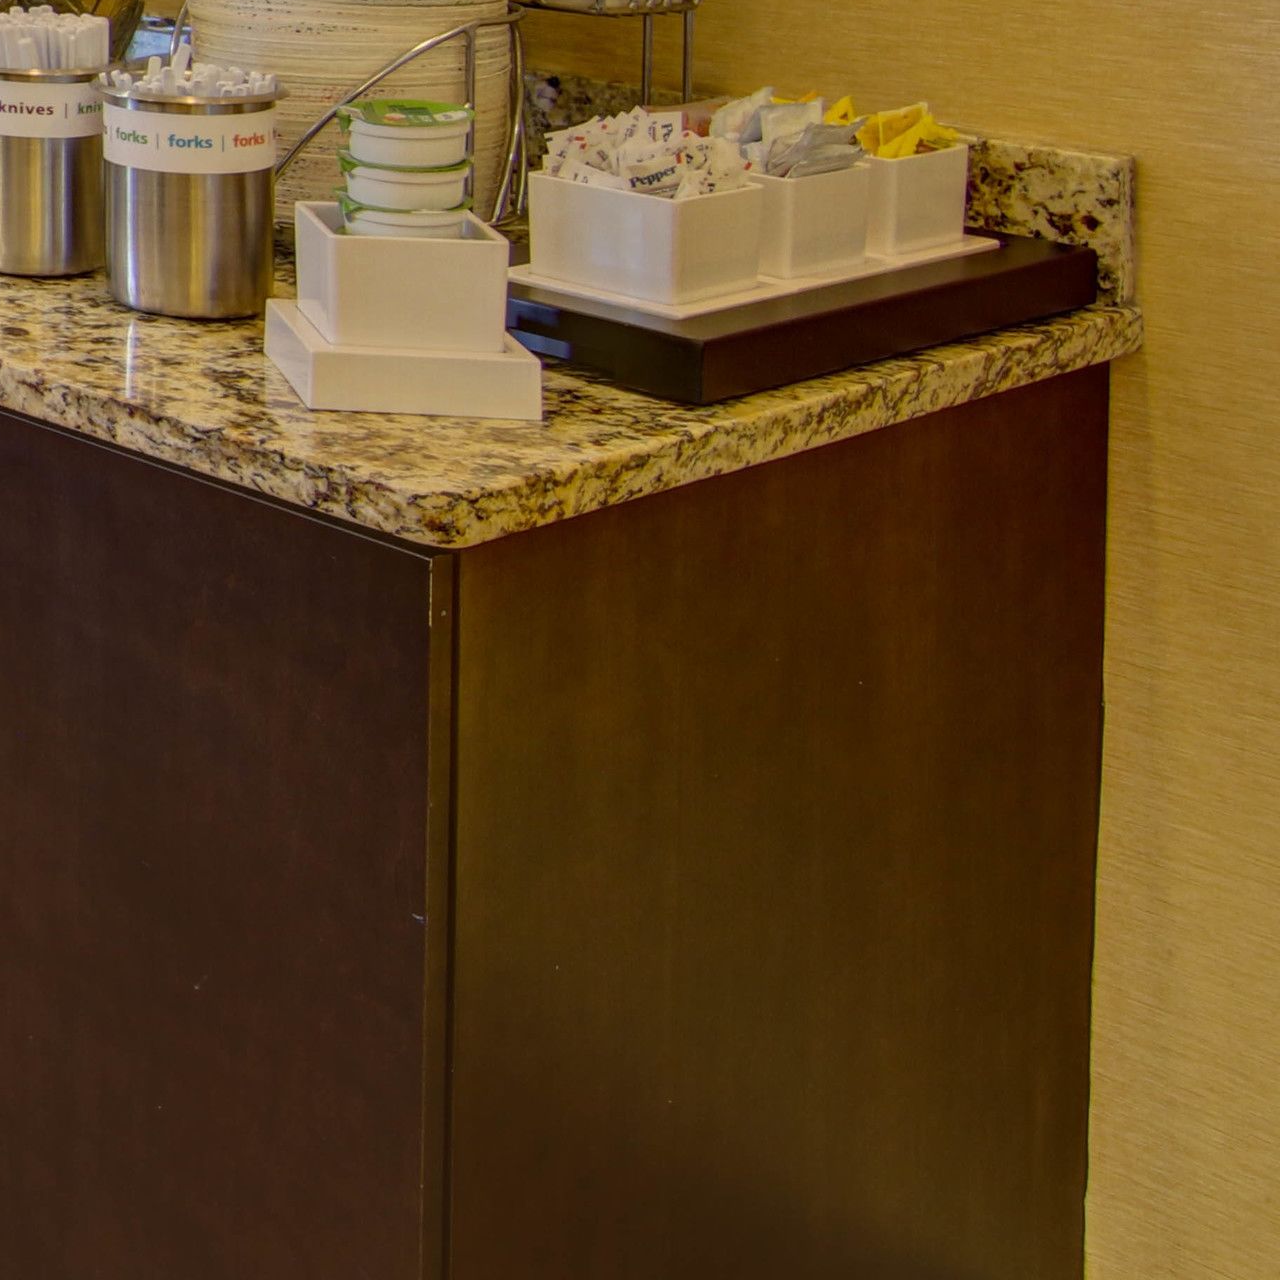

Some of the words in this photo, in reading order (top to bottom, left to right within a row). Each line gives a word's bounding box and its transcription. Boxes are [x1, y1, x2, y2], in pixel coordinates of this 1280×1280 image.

[116, 127, 149, 145] forks
[168, 134, 213, 149] forks
[232, 133, 265, 148] forks
[629, 165, 677, 189] Pepper
